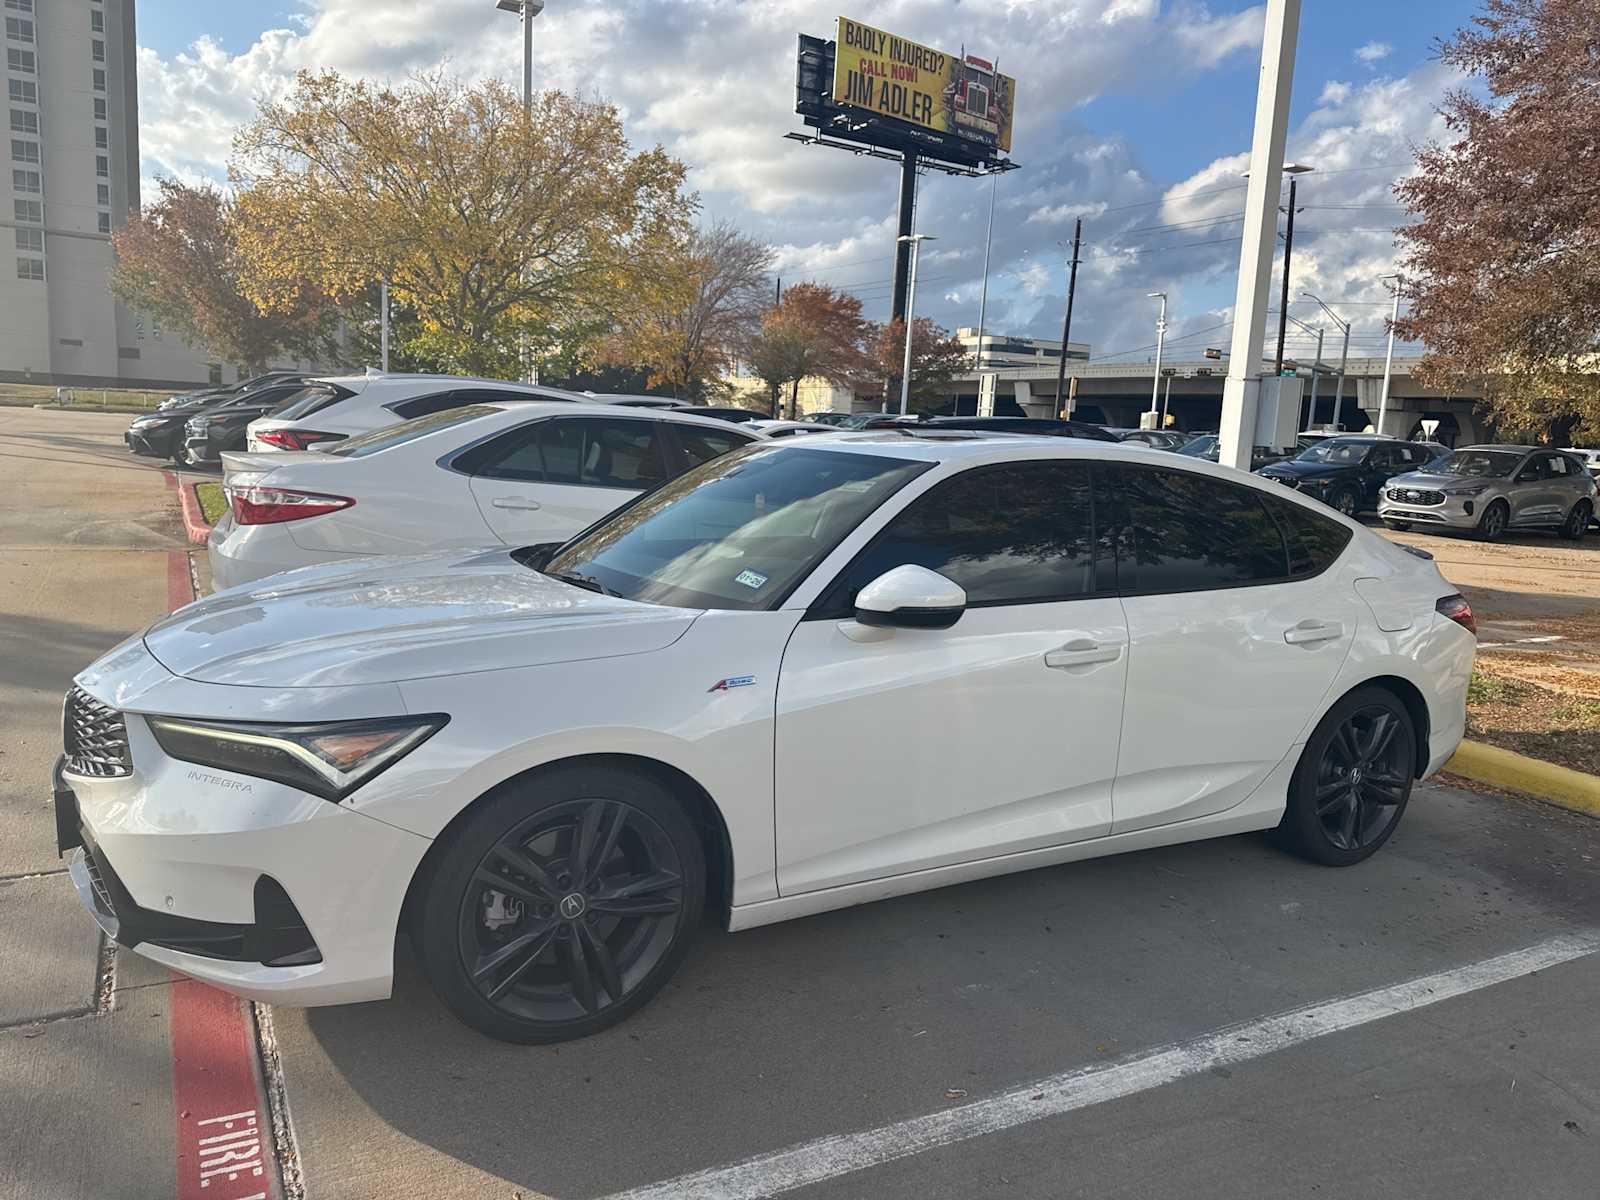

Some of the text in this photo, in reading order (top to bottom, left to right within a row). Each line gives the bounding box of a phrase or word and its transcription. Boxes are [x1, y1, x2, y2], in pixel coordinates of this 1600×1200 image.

[846, 21, 945, 76] BADLY INJURED?
[859, 57, 887, 77] CALL
[844, 69, 933, 125] JIM ADLER
[187, 770, 253, 794] INTEGRA
[198, 1109, 263, 1188] FIRE
